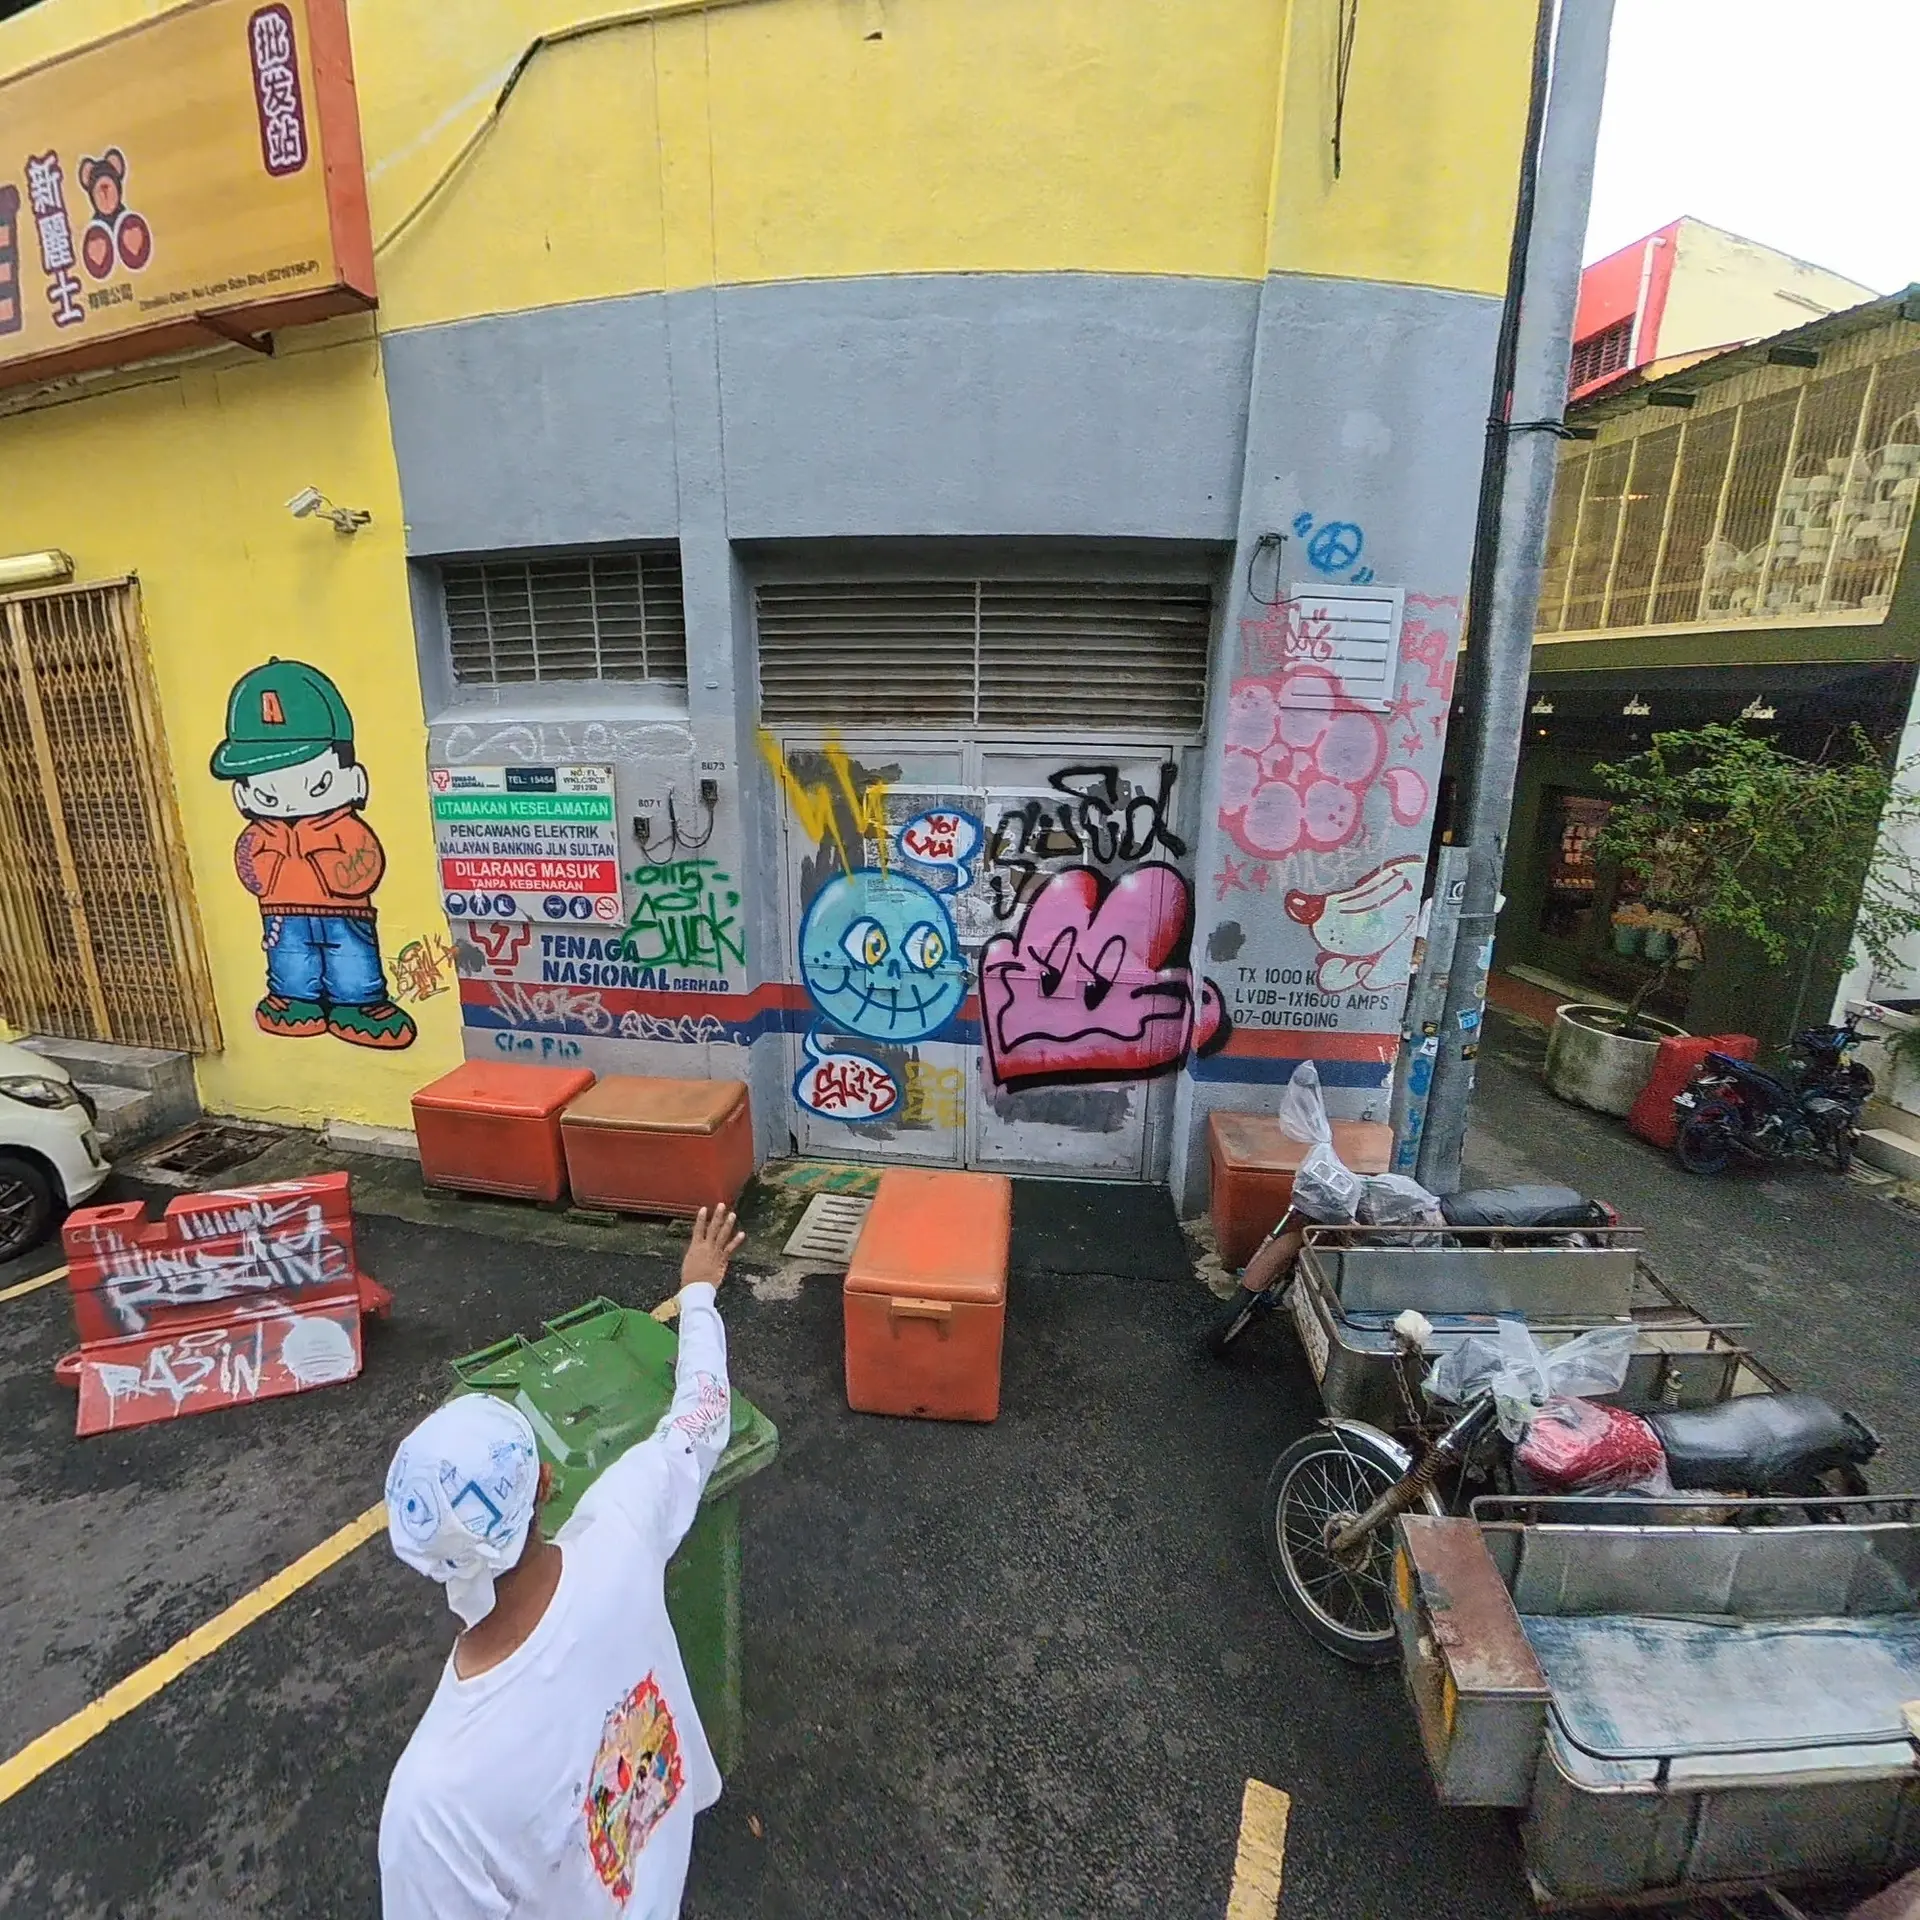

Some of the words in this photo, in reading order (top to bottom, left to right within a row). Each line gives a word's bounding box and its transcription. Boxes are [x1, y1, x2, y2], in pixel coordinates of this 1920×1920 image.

[437, 802, 506, 815] UTAMAKAN
[511, 802, 609, 816] KESELAMATAN
[450, 824, 531, 838] PENCAWANG
[534, 825, 599, 839] ELEKTRIK
[440, 842, 490, 855] MALAYAN
[493, 842, 542, 856] BANKING
[546, 843, 568, 856] JLN
[571, 843, 615, 857] SULTAN
[455, 861, 537, 878] DILARANG
[541, 863, 600, 879] MASUK
[470, 878, 508, 889] TANPA
[509, 879, 584, 891] KEBENARAN
[541, 934, 640, 963] TENAGA
[543, 960, 670, 991] NASIONAL
[1238, 967, 1257, 983] TX
[1265, 968, 1302, 985] 1000
[673, 978, 729, 992] BERHAD
[1346, 995, 1390, 1010] AMPS
